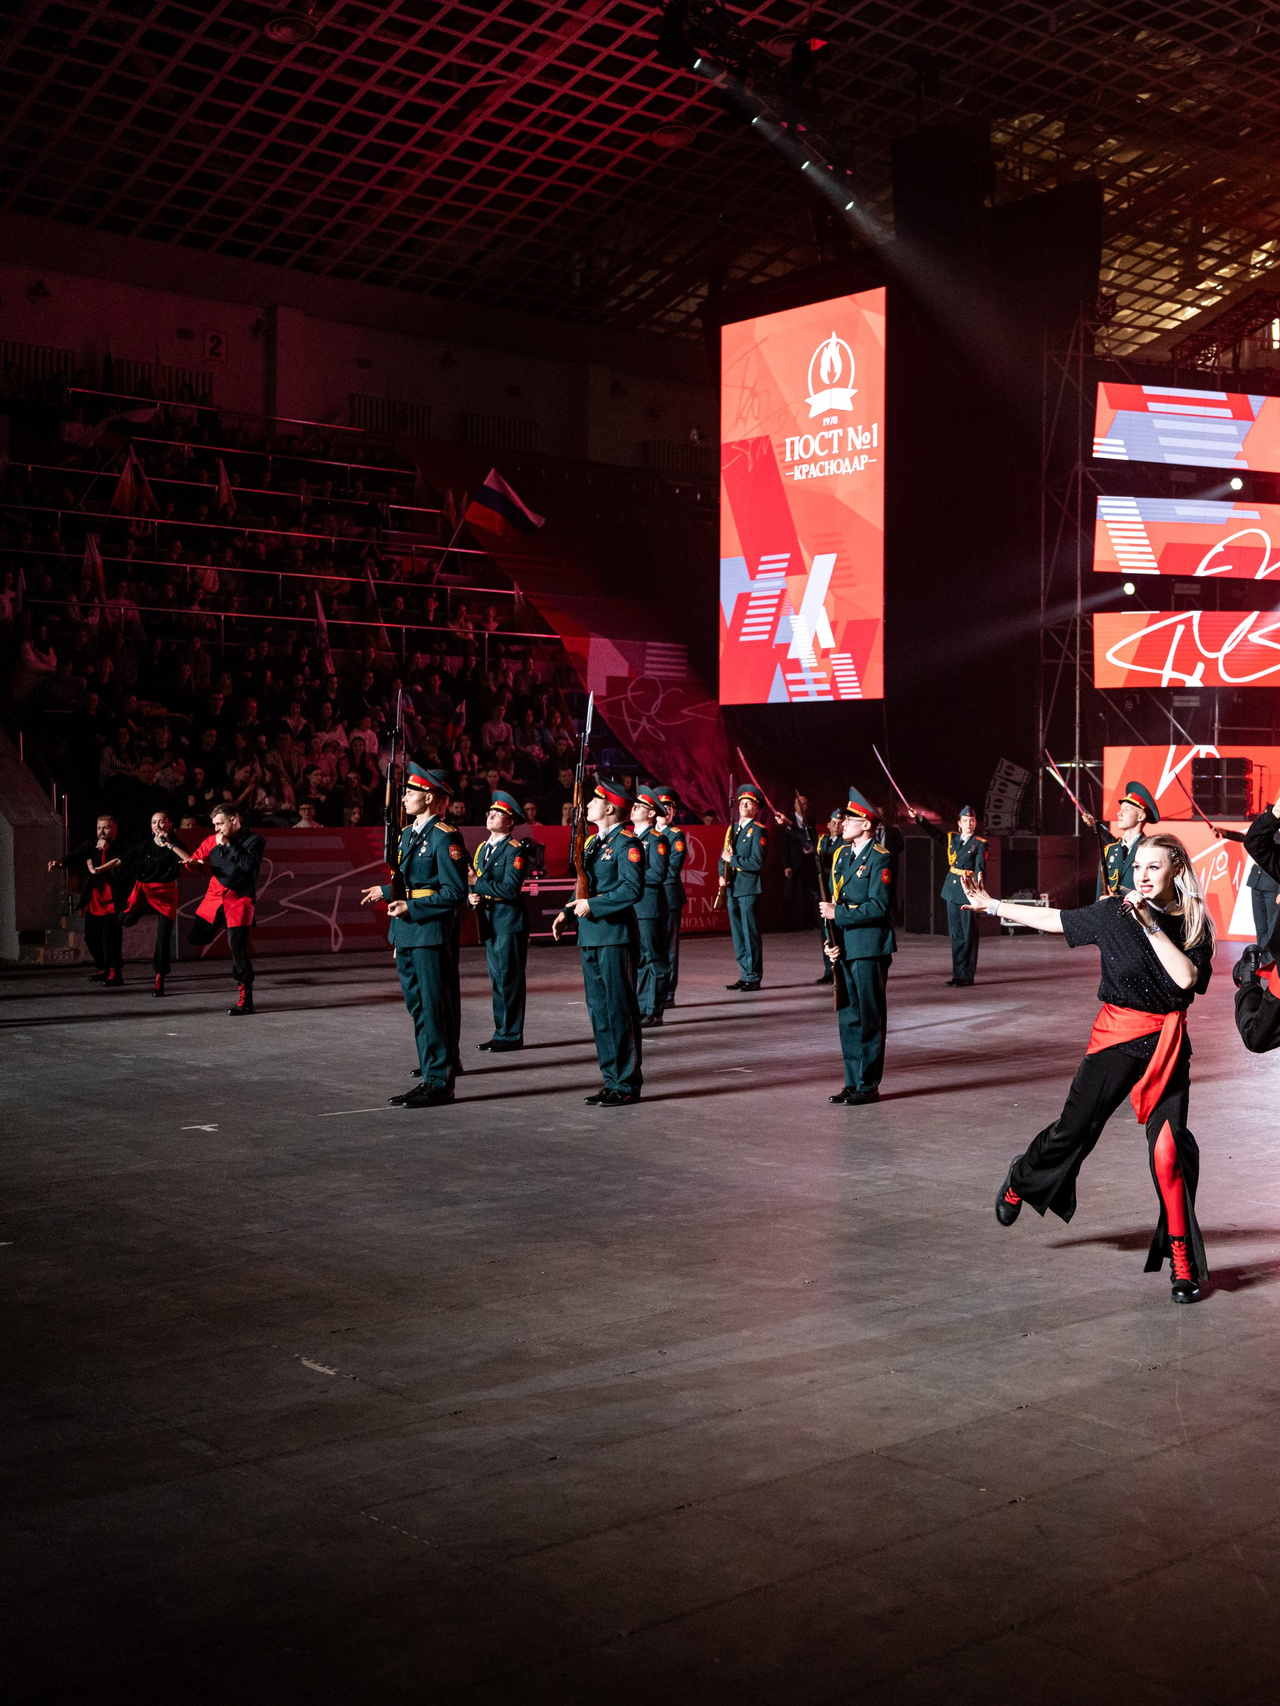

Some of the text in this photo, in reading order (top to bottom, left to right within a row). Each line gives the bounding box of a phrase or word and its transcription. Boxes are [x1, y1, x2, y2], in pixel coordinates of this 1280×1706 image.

[209, 334, 222, 357] 2
[784, 422, 878, 462] ПОСТ №1
[793, 454, 869, 481] КРАСНОДАР
[680, 917, 719, 929] НОДАР
